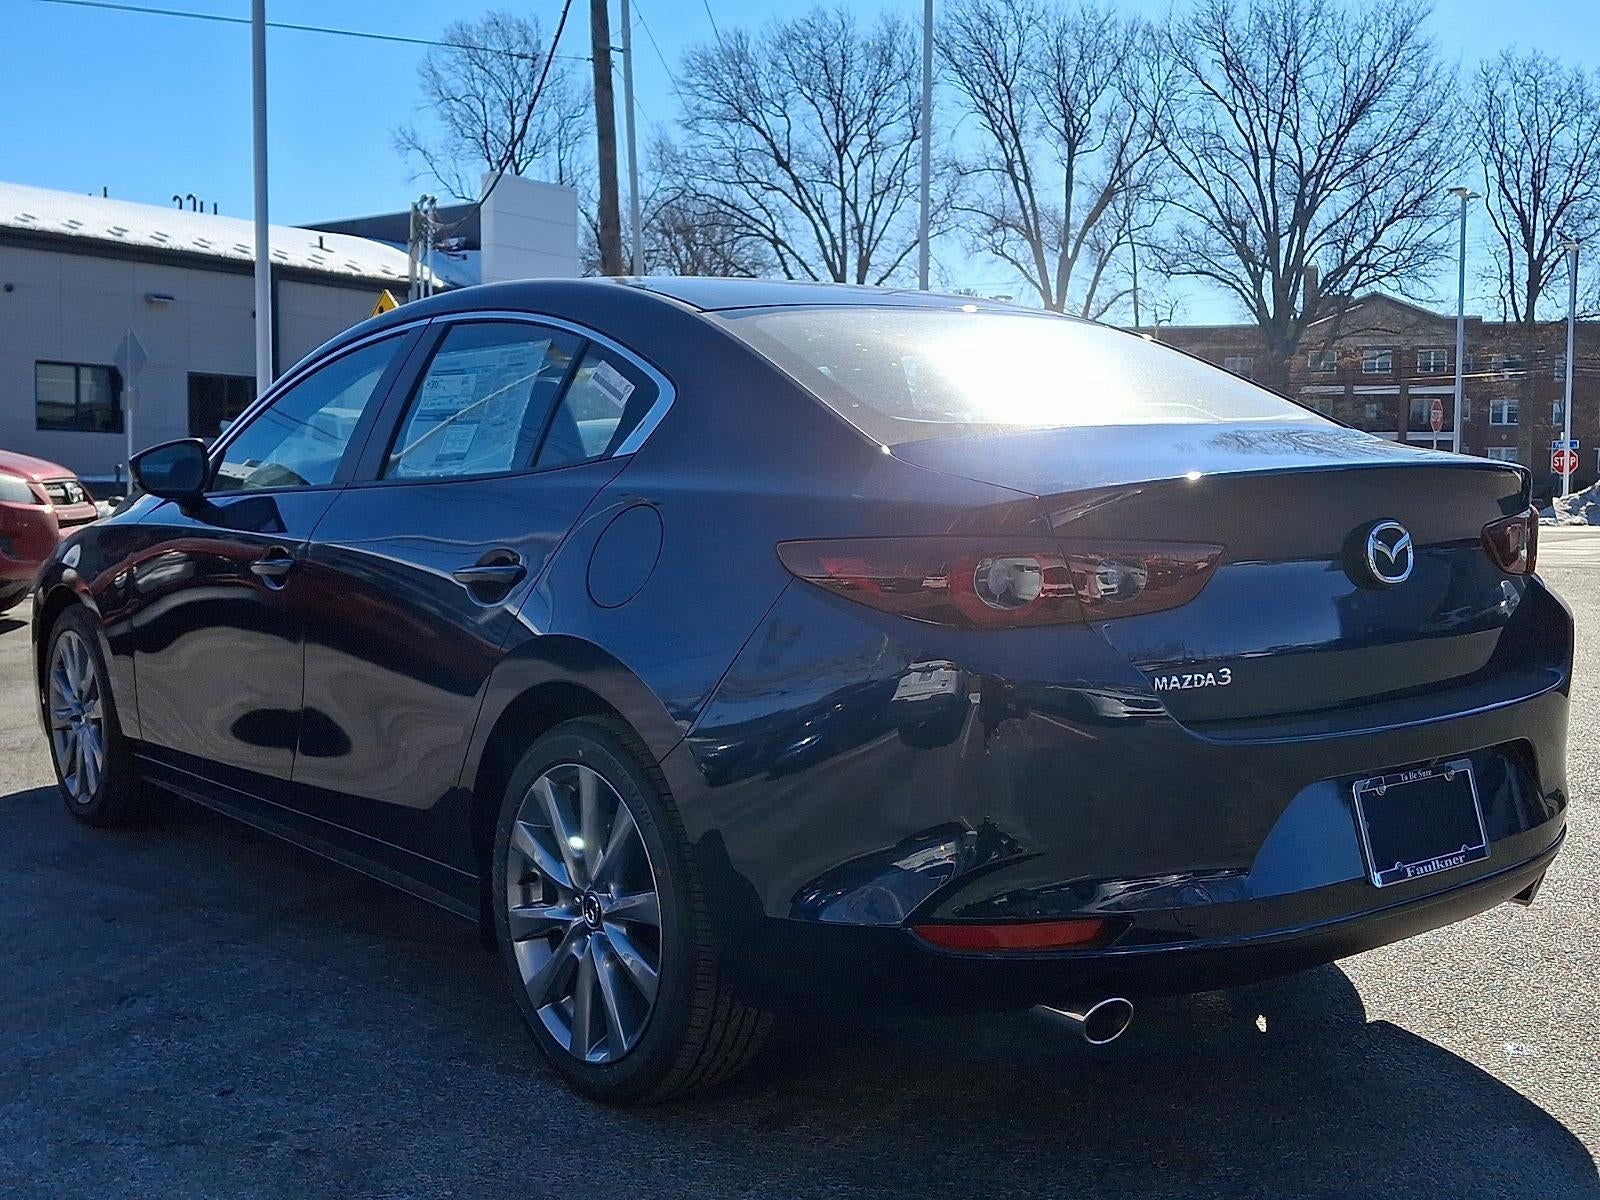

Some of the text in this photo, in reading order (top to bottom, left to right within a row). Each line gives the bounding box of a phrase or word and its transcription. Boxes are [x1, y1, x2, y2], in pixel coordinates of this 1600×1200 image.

[1553, 456, 1576, 467] STP
[1400, 769, 1433, 782] To Be Sure
[1405, 854, 1466, 878] Faulkner
